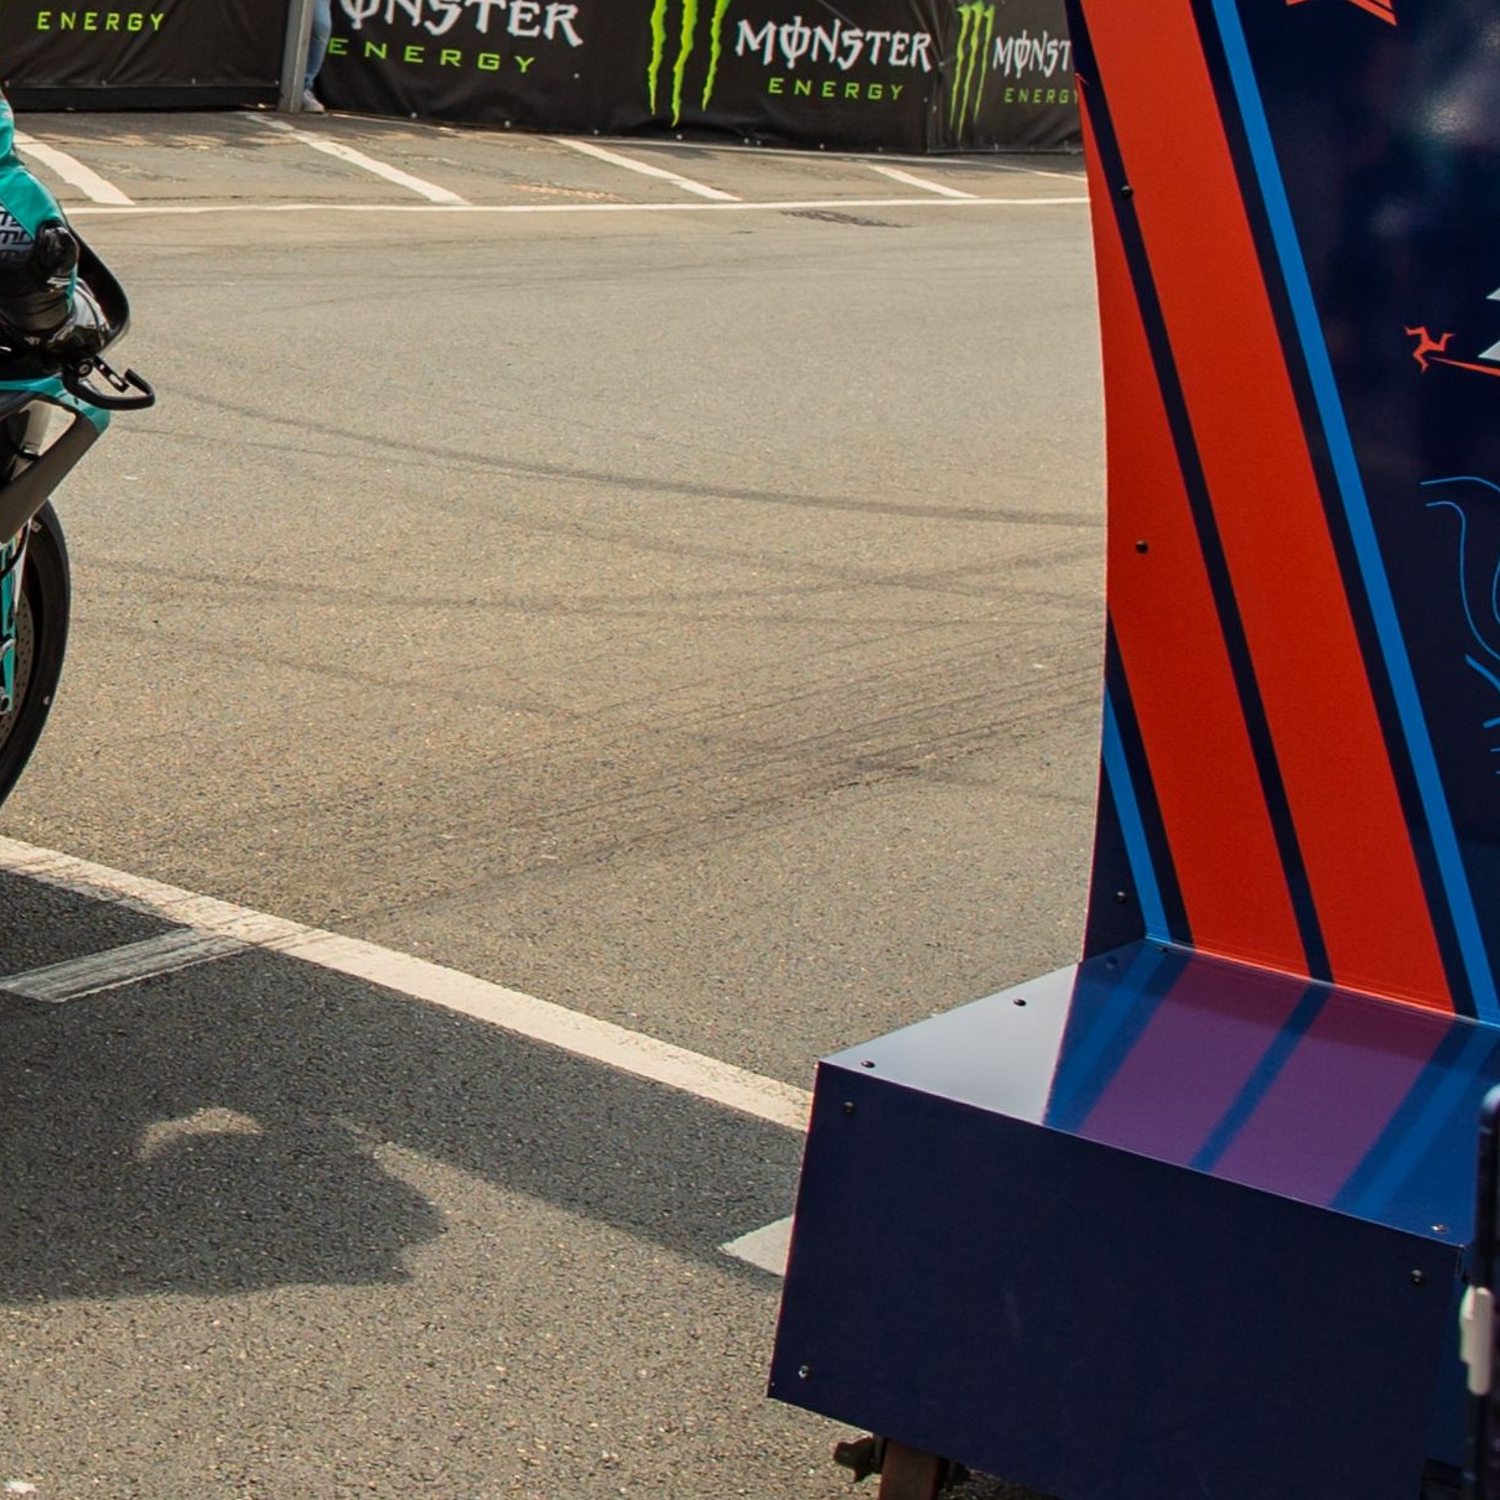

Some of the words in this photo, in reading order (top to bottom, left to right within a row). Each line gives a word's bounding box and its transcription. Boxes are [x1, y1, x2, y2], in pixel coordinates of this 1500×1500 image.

[37, 11, 165, 32] ENERGY
[328, 38, 536, 73] ENERGY
[735, 16, 930, 73] MONSTER
[992, 29, 1072, 79] MONST
[769, 77, 904, 101] ENERGY
